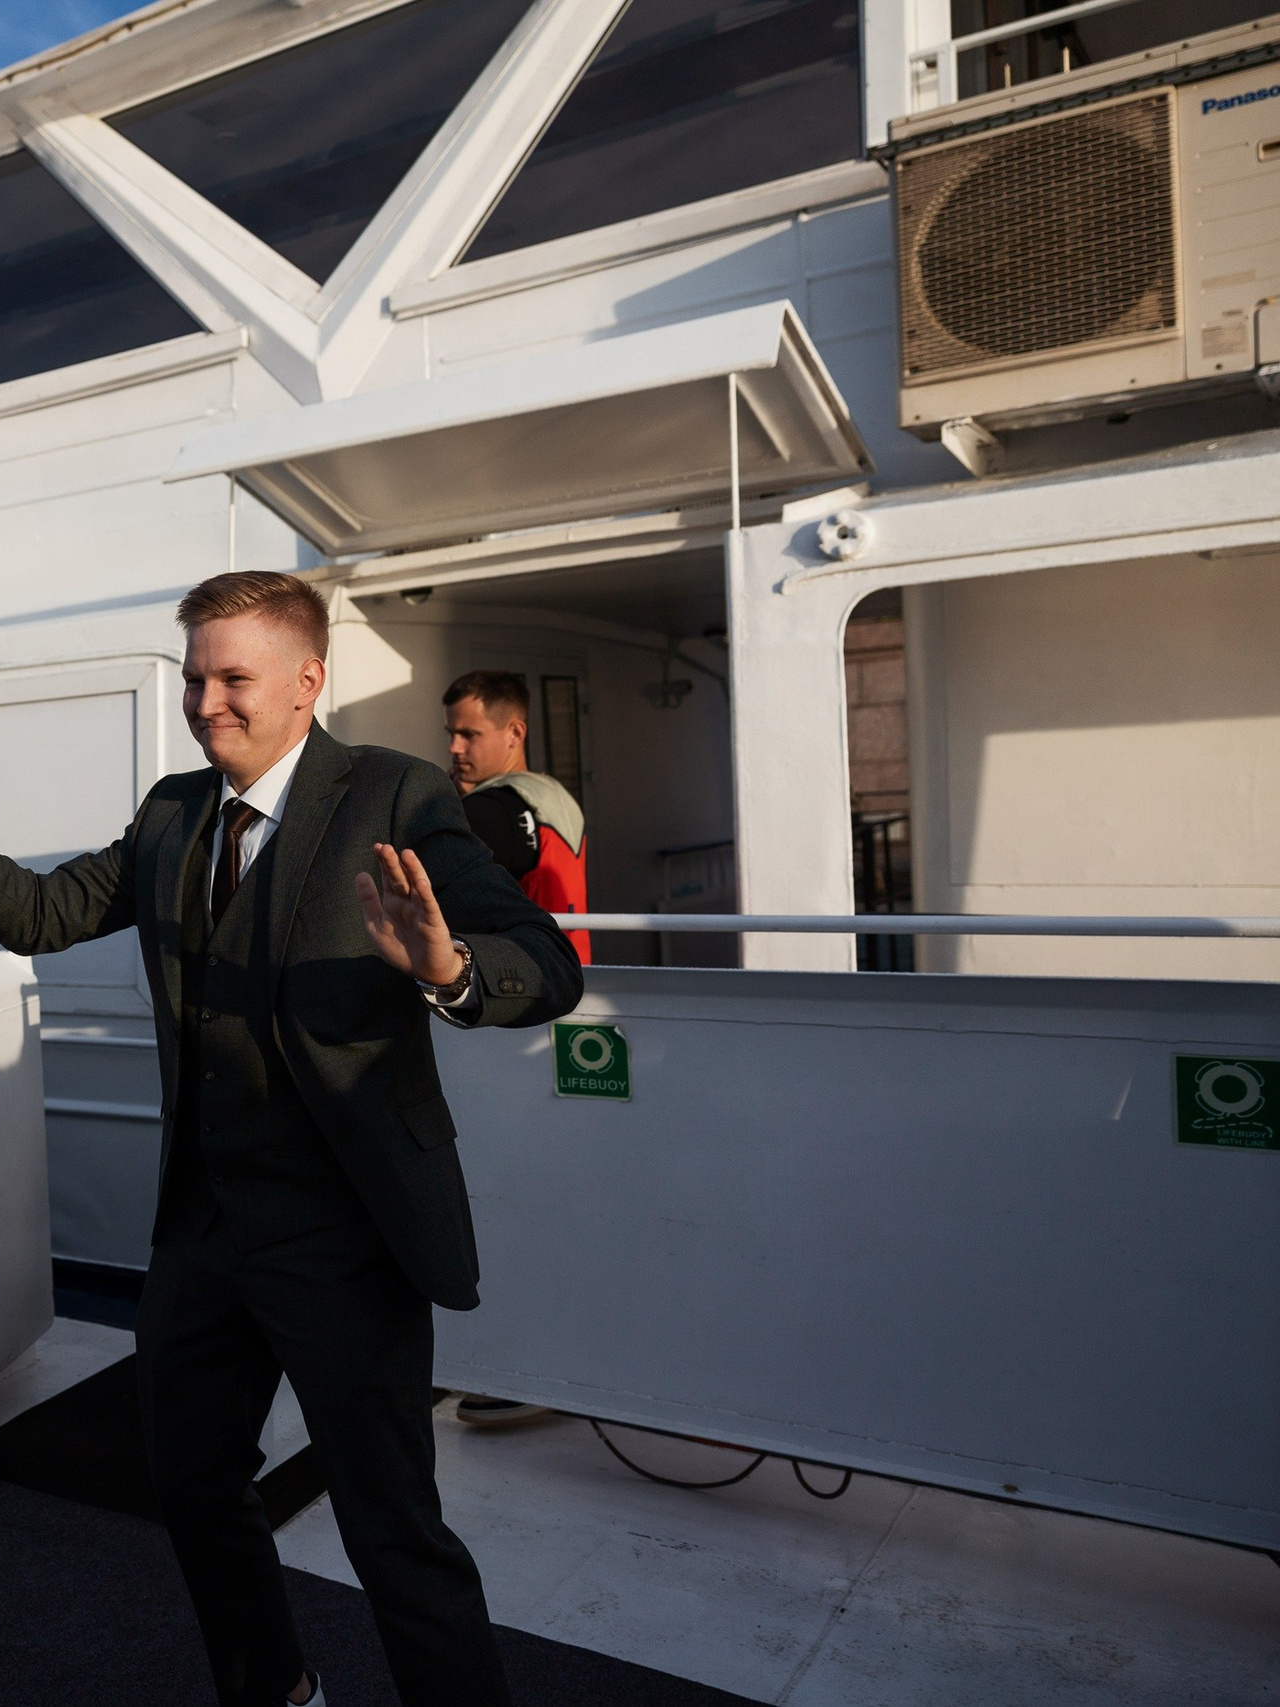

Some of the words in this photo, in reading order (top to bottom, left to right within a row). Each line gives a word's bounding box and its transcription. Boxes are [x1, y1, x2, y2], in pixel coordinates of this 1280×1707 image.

[560, 1077, 627, 1091] LIFEBUOY
[1216, 1129, 1267, 1139] LIFEBUOY
[1216, 1137, 1242, 1146] WITH
